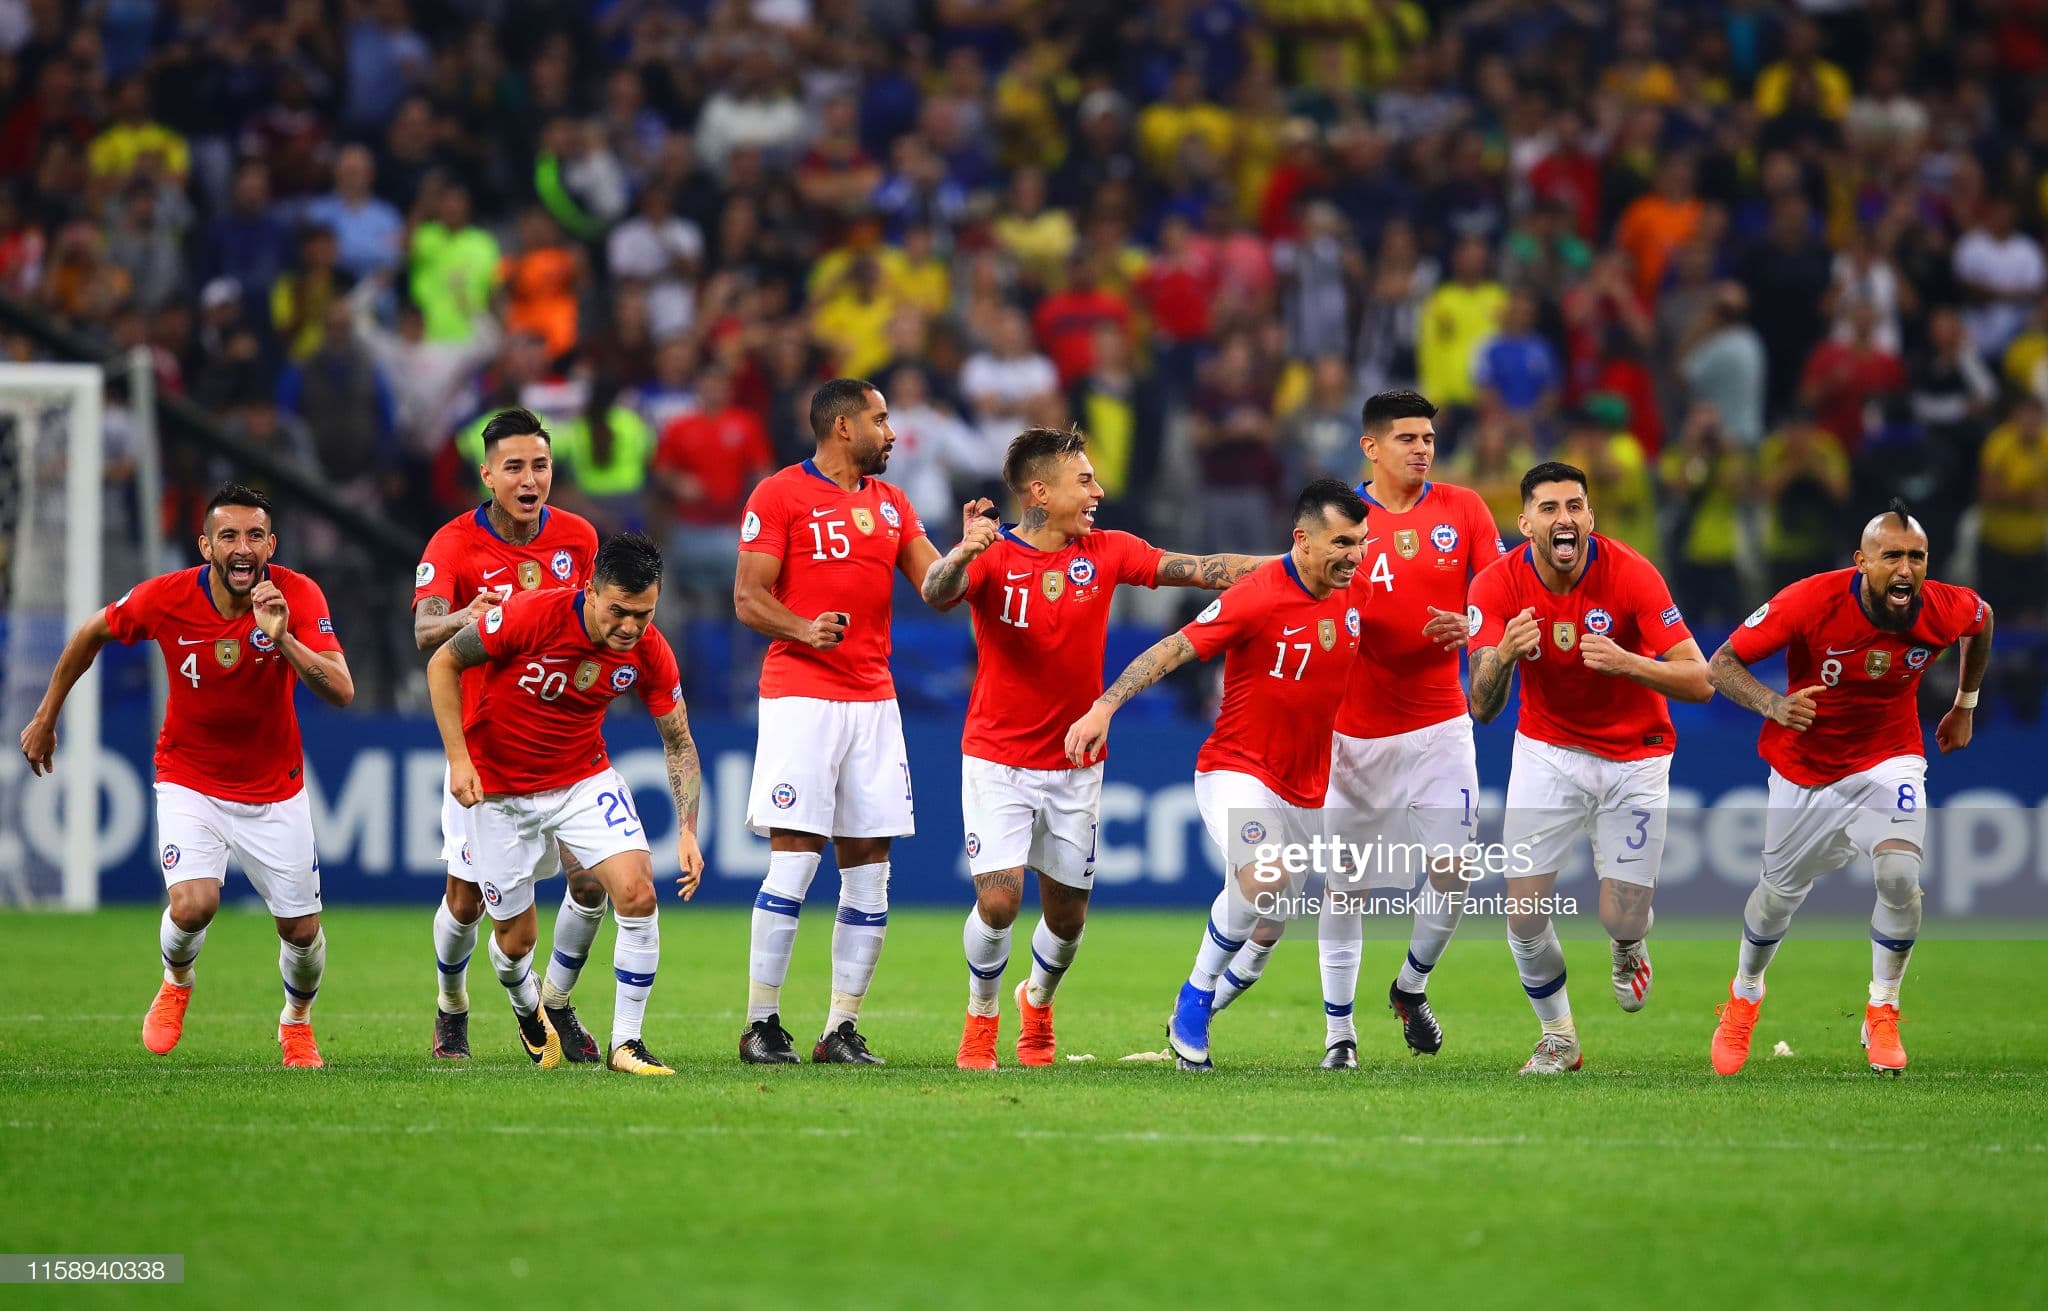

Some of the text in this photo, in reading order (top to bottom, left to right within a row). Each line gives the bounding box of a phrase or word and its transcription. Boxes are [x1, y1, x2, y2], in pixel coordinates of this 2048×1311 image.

[809, 521, 850, 560] 15
[1370, 553, 1394, 592] 4
[1000, 585, 1029, 628] 11
[180, 653, 200, 688] 4
[1269, 641, 1311, 681] 17
[1820, 658, 1843, 687] 8
[518, 662, 568, 701] 20
[1897, 783, 1917, 813] 8
[1625, 809, 1651, 850] 3
